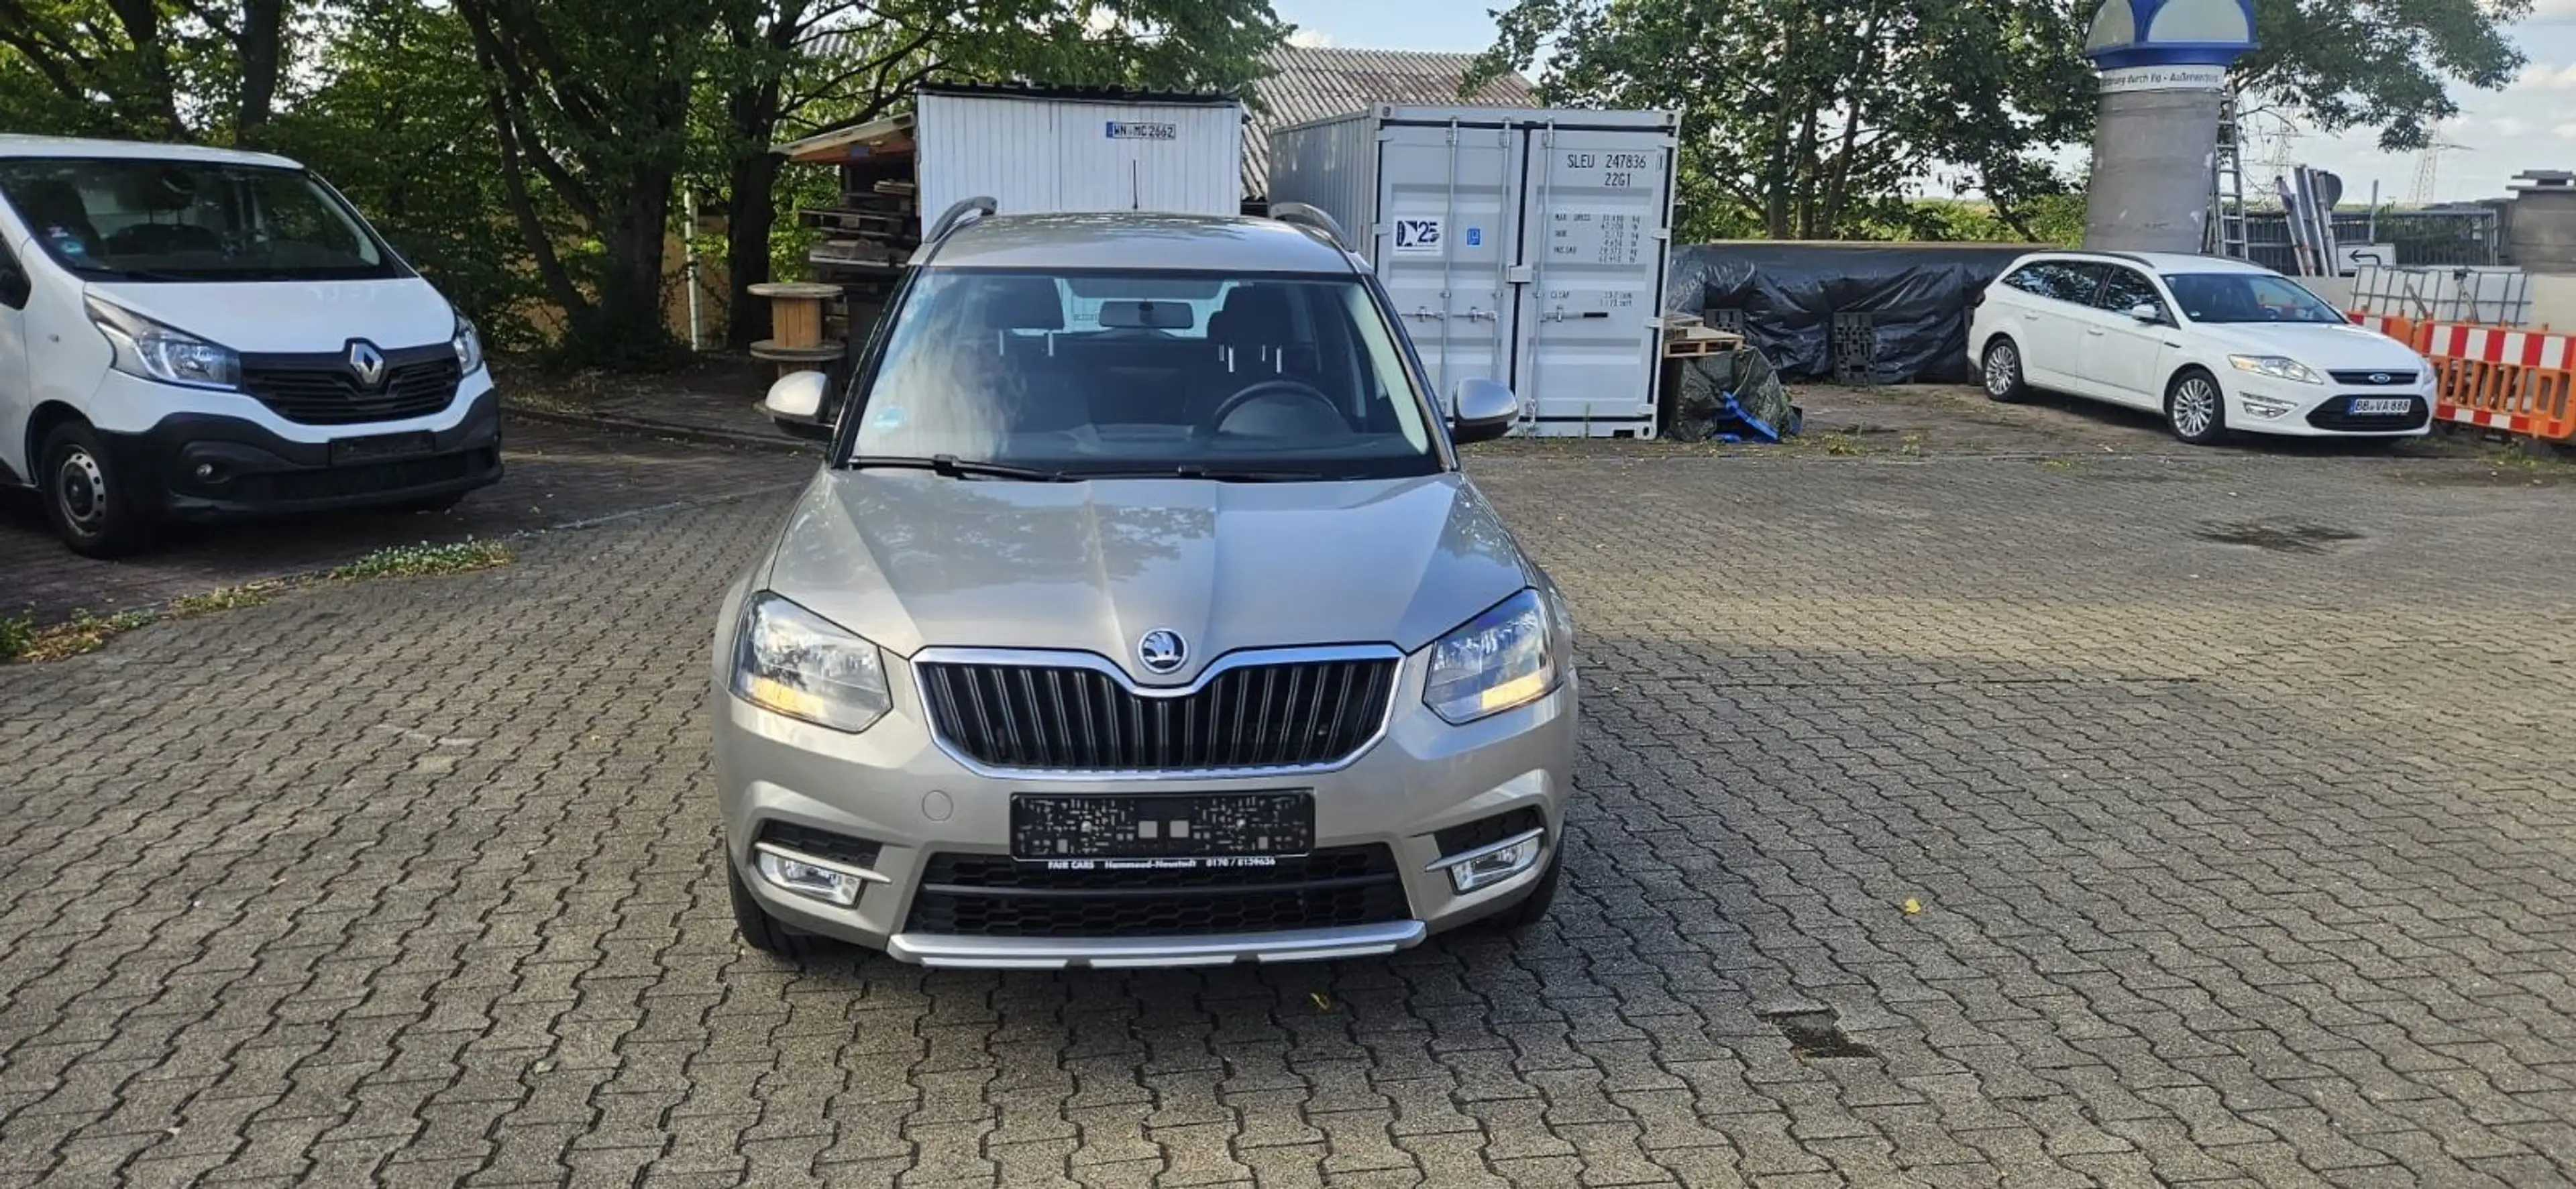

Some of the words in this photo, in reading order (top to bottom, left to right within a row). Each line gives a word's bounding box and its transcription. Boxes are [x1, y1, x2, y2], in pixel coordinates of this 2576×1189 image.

[1567, 154, 1595, 168] SLEU
[1605, 154, 1647, 169] 247836
[1605, 172, 1631, 187] 22G1
[1071, 860, 1095, 870] CARS
